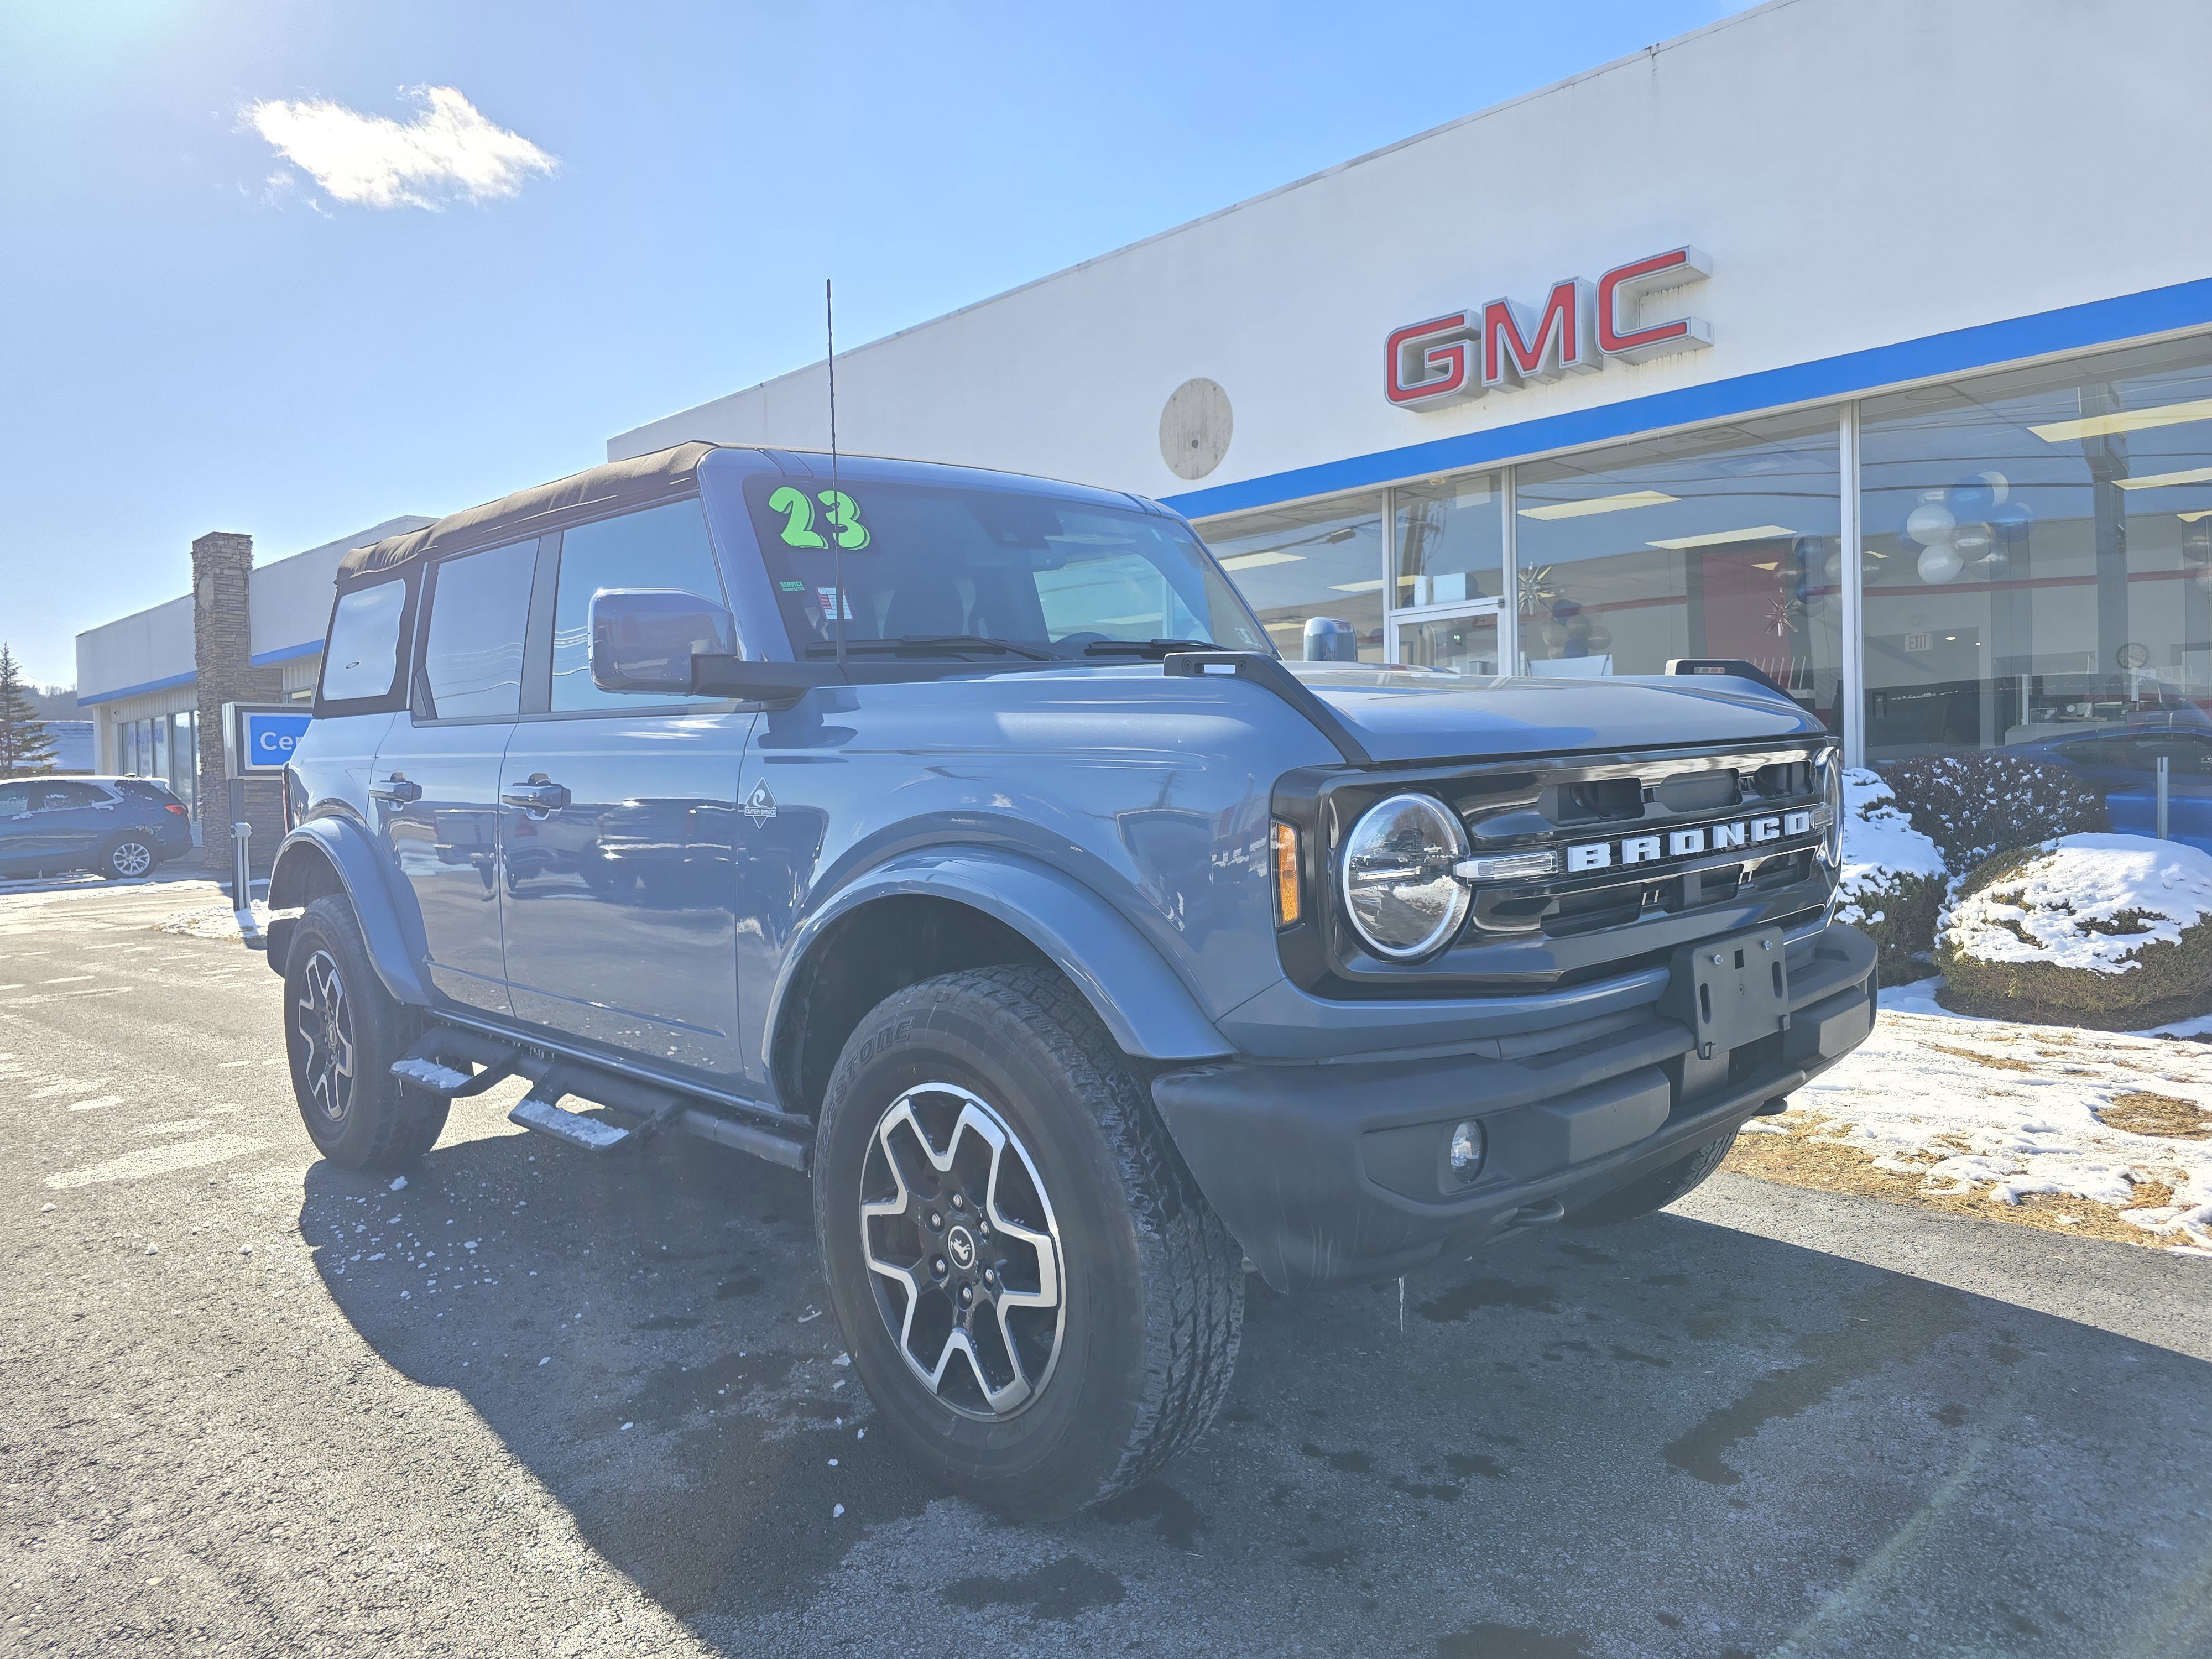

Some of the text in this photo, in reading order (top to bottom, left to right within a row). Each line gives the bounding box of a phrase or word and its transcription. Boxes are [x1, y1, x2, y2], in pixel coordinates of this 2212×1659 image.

[1384, 245, 1693, 406] GMC
[769, 487, 870, 550] 23
[1909, 634, 1927, 650] EXIT
[1568, 812, 1809, 872] BRONCO
